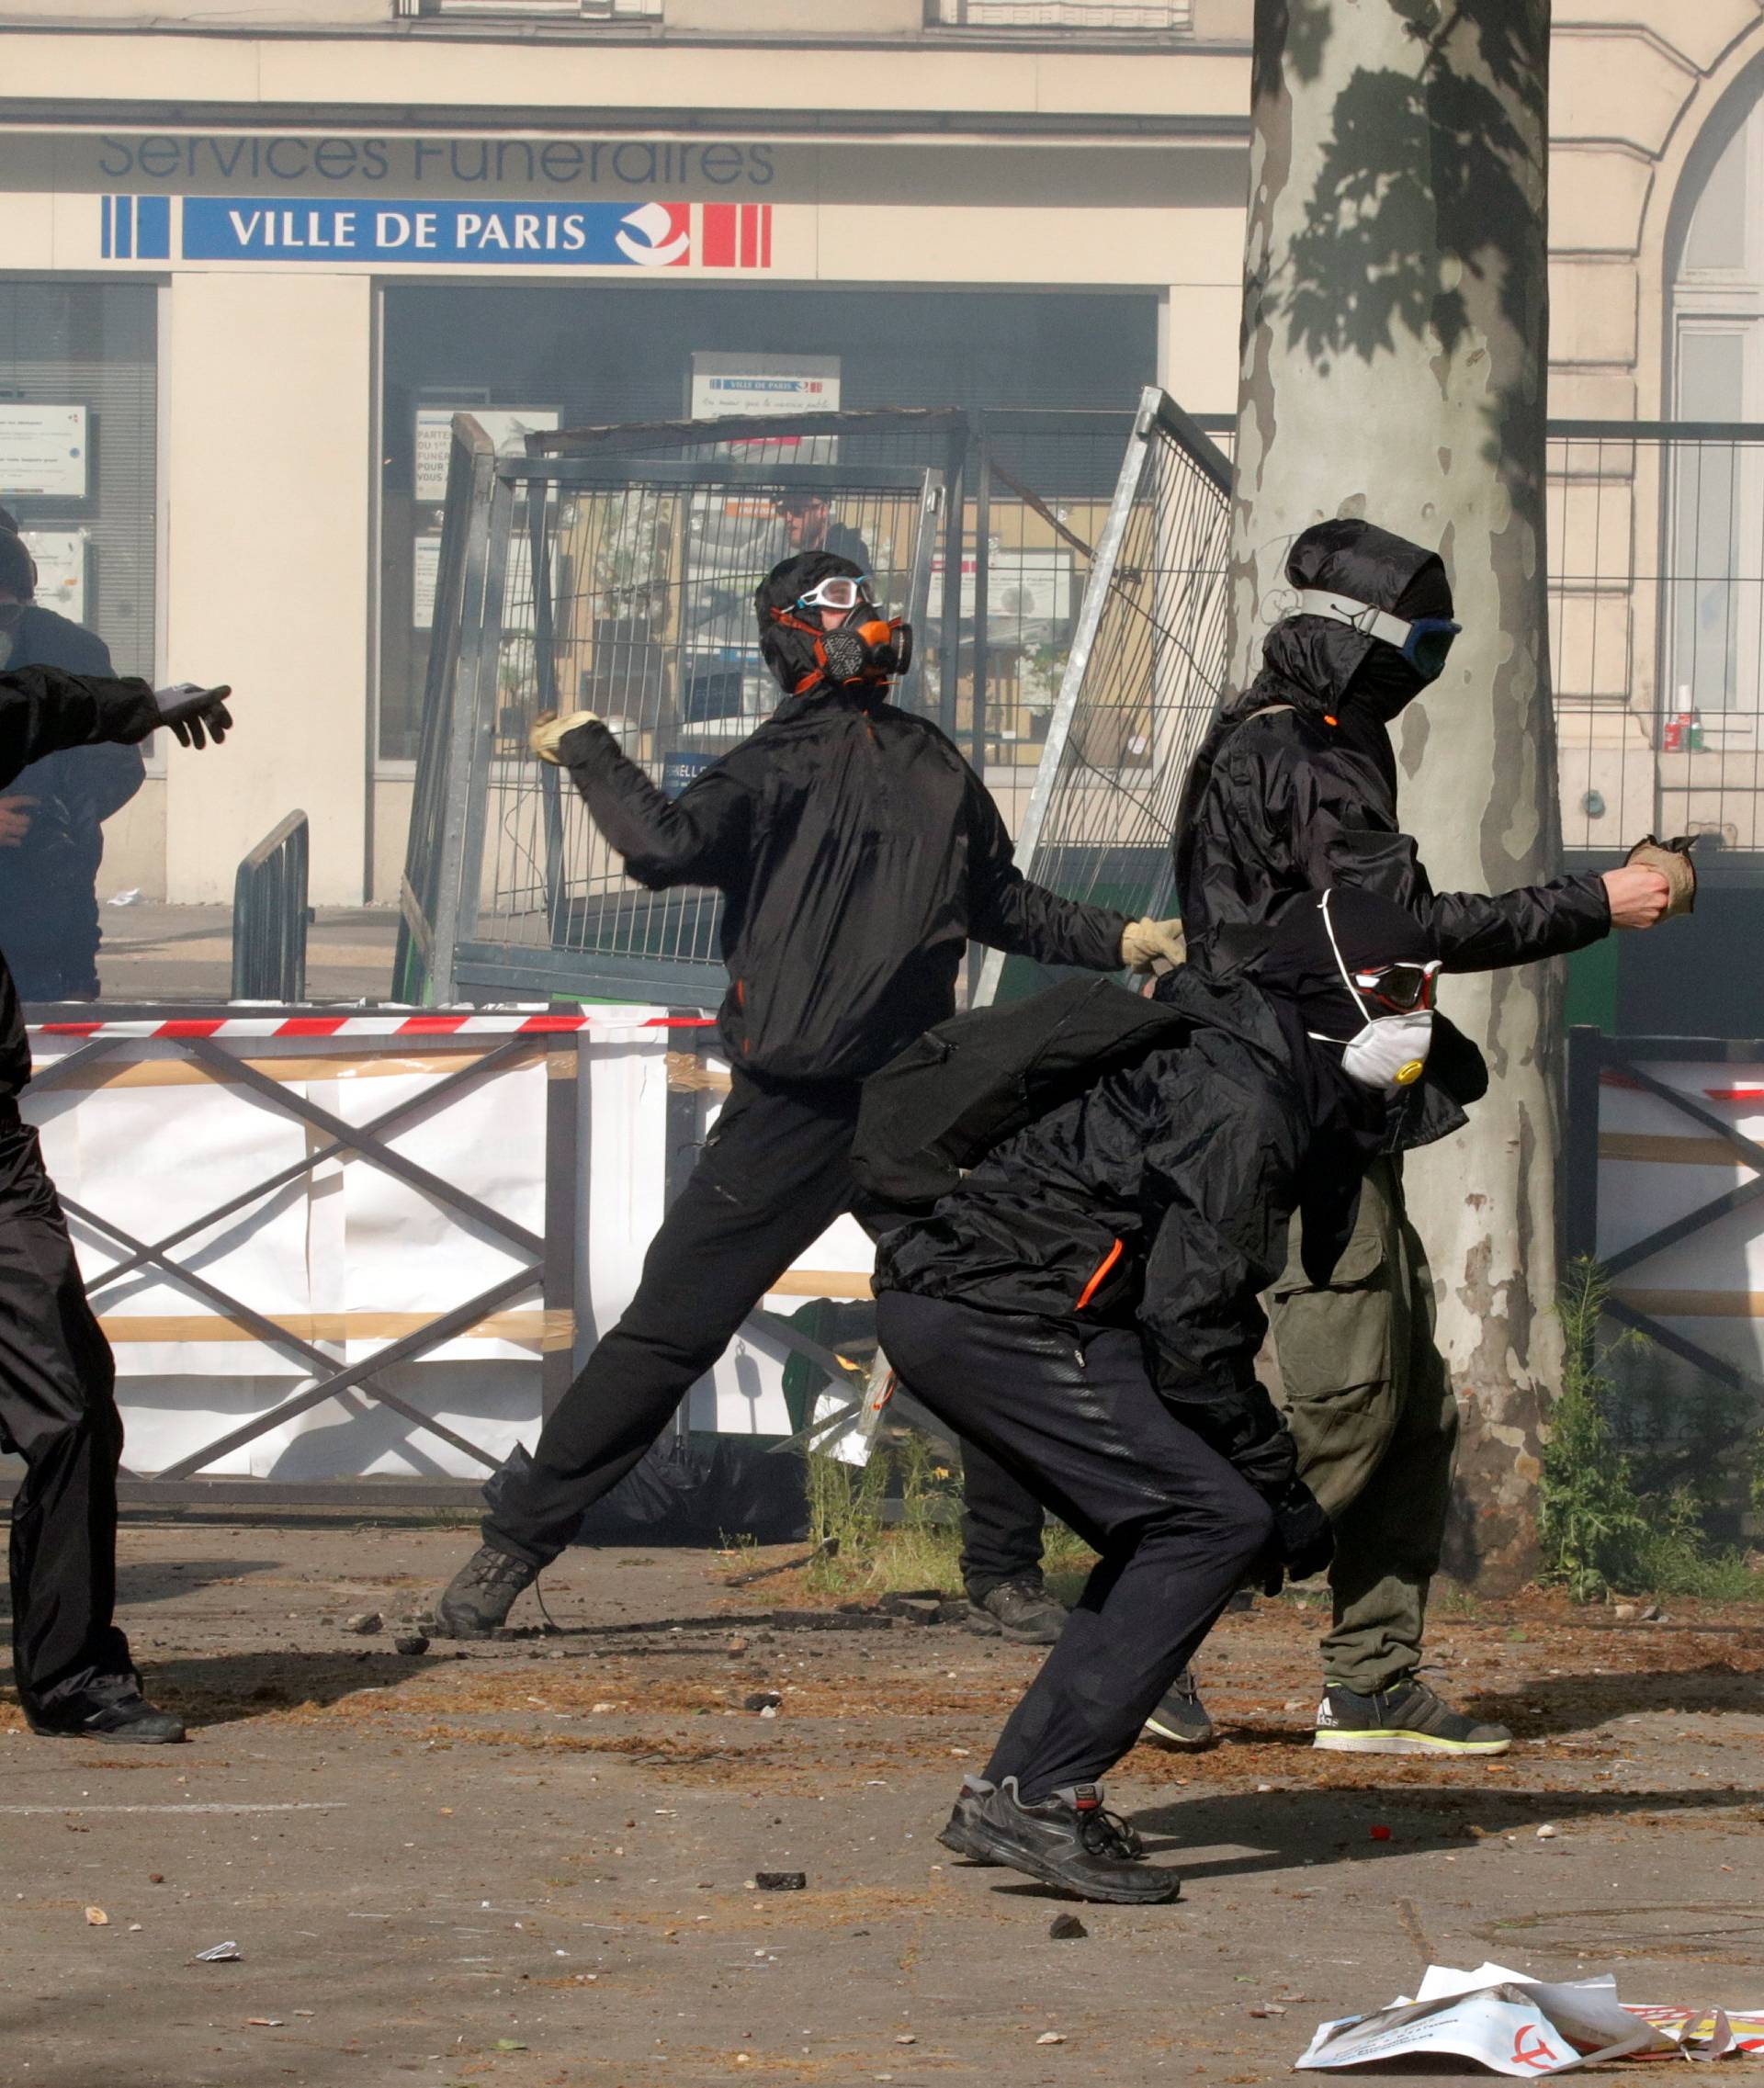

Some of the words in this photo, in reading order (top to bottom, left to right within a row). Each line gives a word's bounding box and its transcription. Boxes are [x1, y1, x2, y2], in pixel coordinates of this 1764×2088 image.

[99, 137, 389, 180] Services
[229, 210, 356, 246] VILLE
[376, 212, 436, 248] DE
[457, 213, 586, 250] PARIS
[730, 380, 752, 389] VILLE
[754, 381, 765, 390] DE
[768, 381, 792, 390] PARIS
[418, 462, 443, 471] POUR
[418, 473, 443, 482] VOUS
